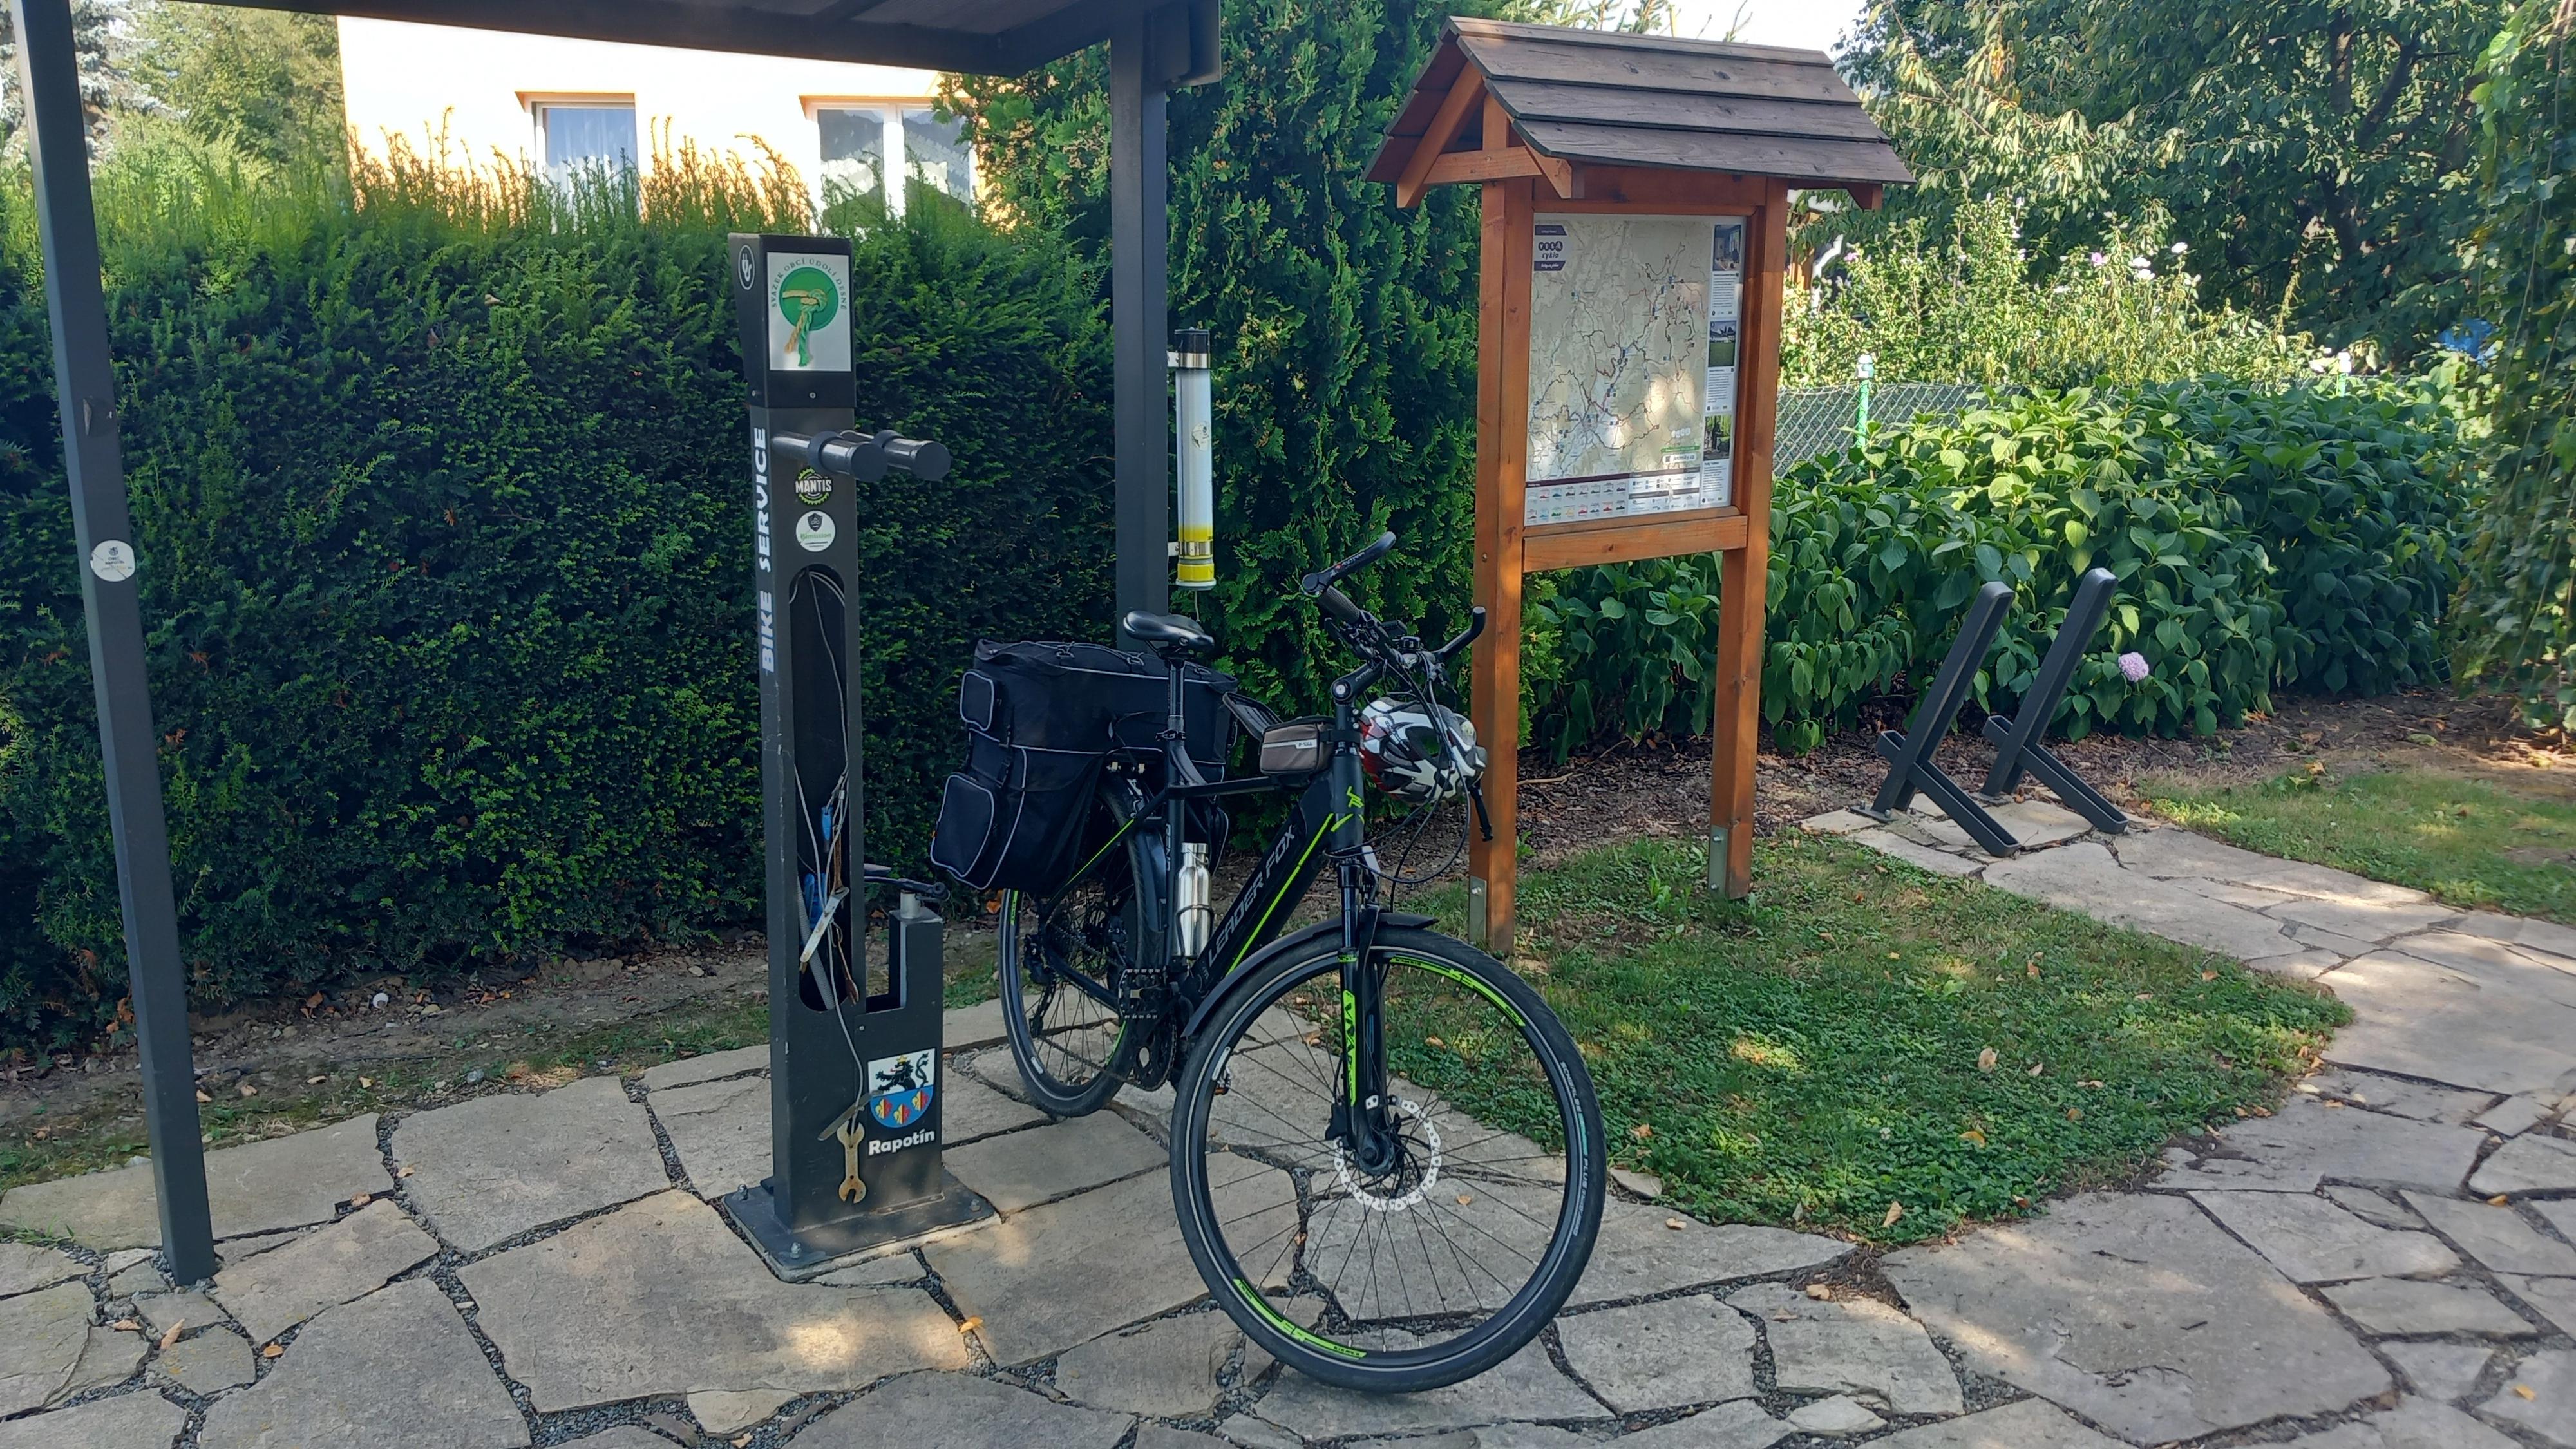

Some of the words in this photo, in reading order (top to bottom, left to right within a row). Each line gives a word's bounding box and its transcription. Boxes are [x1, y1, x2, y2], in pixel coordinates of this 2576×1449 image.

[771, 272, 784, 308] SVAZEK
[784, 257, 806, 272] OBCÍ
[809, 258, 837, 277] ÚDOLÍ
[753, 427, 772, 573] SERVICE
[795, 479, 832, 494] MANTIS
[759, 590, 775, 674] BIKE
[1208, 871, 1264, 967] LEADER
[1265, 824, 1295, 879] FOX
[869, 1130, 935, 1156] Rapotín
